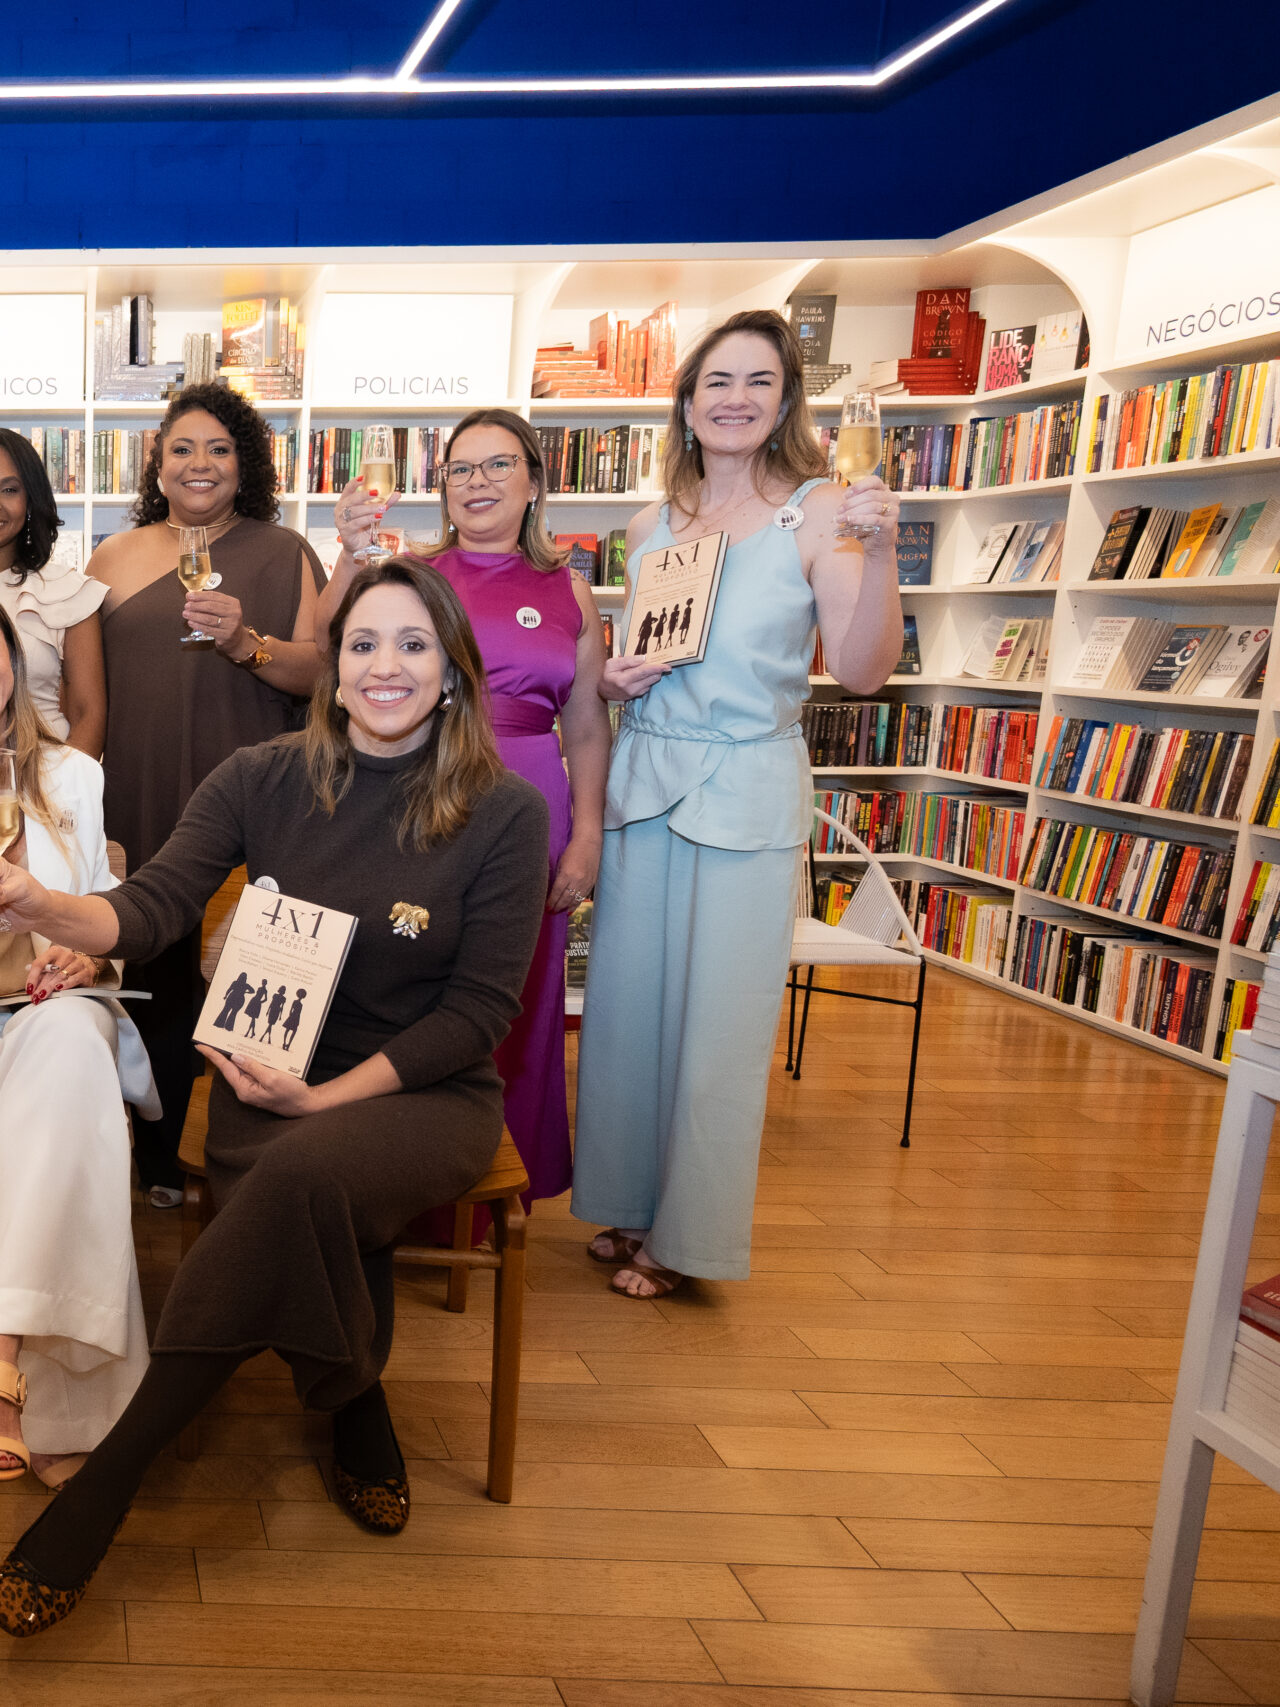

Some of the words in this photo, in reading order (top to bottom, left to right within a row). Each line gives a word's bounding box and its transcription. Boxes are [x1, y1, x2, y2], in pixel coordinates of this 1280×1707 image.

[926, 293, 967, 304] DAN
[801, 307, 822, 315] PAULA
[925, 304, 965, 316] BROWN
[1146, 291, 1280, 347] NEGÓCIOS
[991, 329, 1024, 349] LIDE
[988, 343, 1035, 368] RANÇA
[987, 363, 1018, 378] HUMA
[354, 376, 469, 395] POLICIAIS
[984, 374, 1023, 391] NIZADA
[896, 536, 929, 545] ROWN
[897, 552, 928, 561] RIGEM
[255, 923, 309, 945] MULHERES
[257, 931, 318, 956] PROPÓSITO
